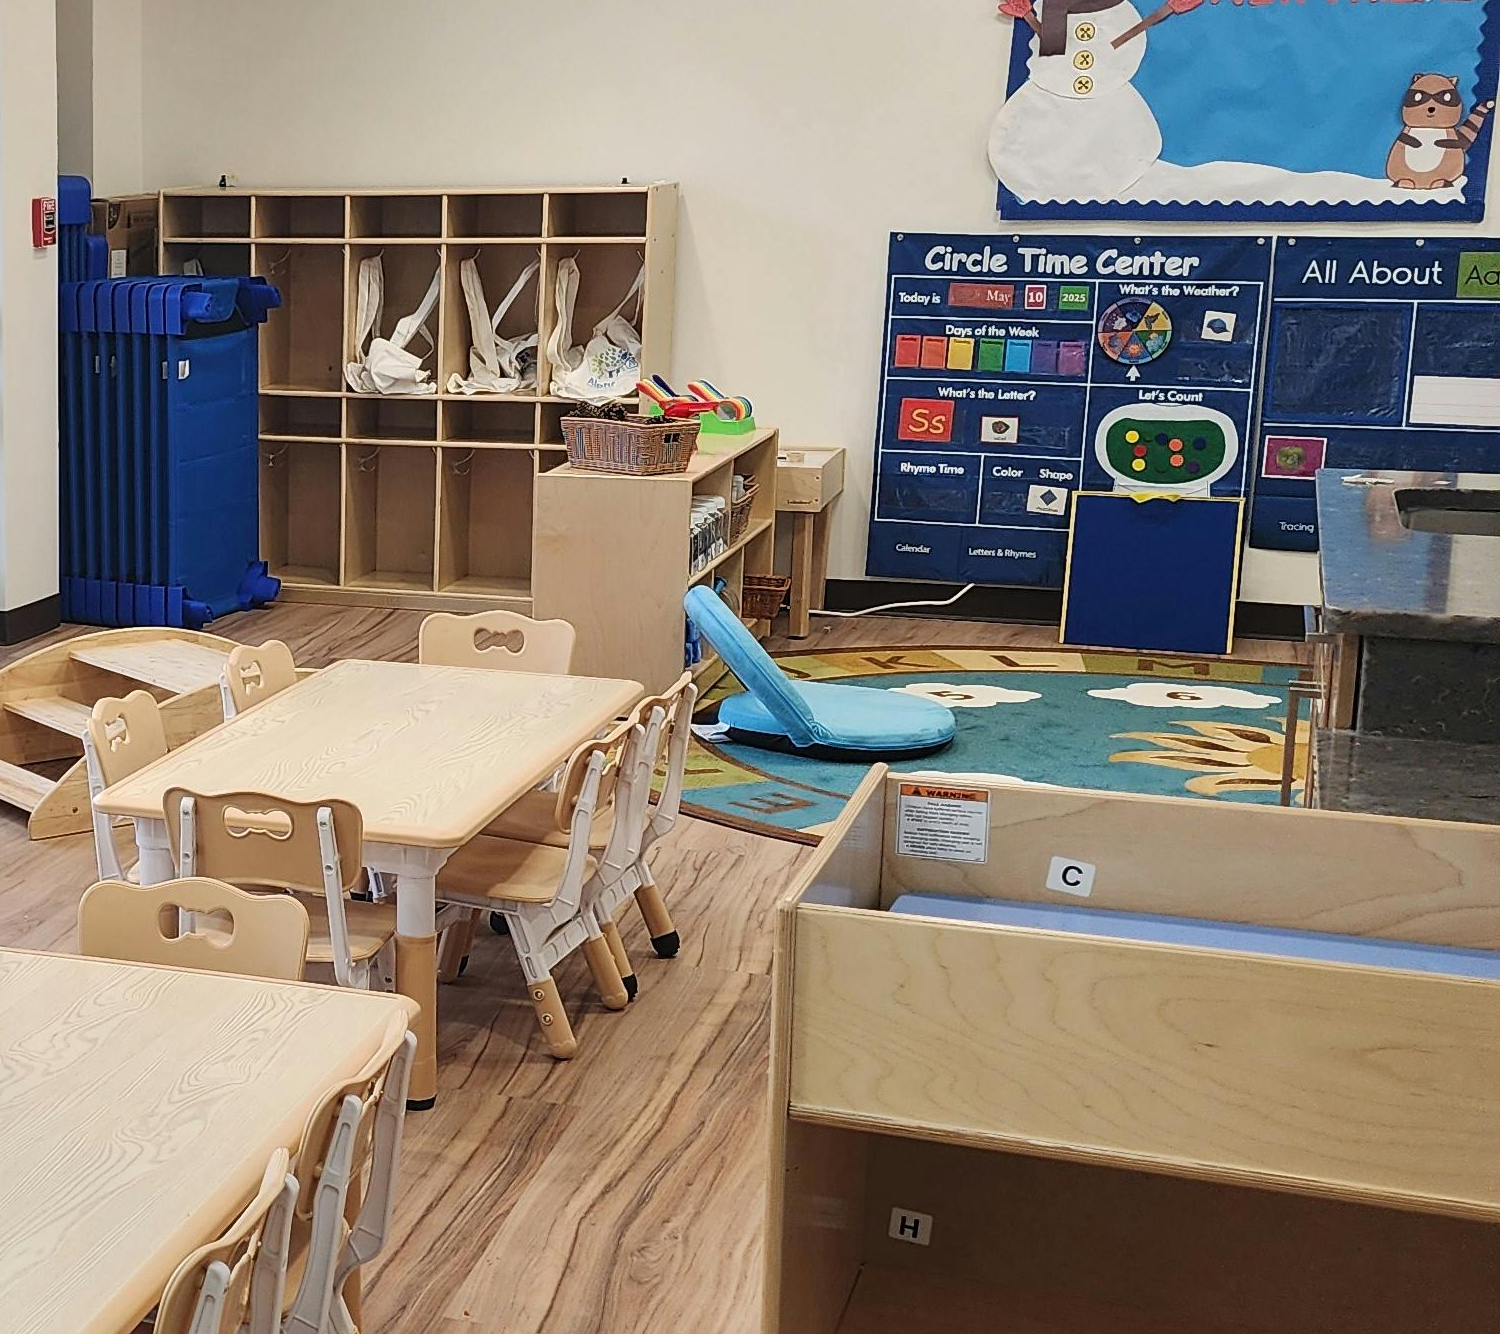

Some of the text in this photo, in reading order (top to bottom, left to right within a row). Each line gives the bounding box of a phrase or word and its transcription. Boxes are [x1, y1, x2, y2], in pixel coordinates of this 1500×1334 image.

[925, 246, 1200, 277] Circle Time Center
[1301, 259, 1337, 284] All
[1348, 260, 1443, 285] About
[1028, 291, 1043, 303] 10
[1118, 283, 1240, 297] What's the Weather?
[898, 292, 941, 306] Today is
[985, 290, 1012, 305] May
[1062, 293, 1086, 303] 2025
[945, 325, 1040, 338] Days of the Week
[938, 387, 1036, 401] What's the Letter?
[1138, 389, 1204, 403] Let's Count
[908, 408, 946, 434] Ss
[900, 463, 964, 475] Rhyme Time
[992, 466, 1024, 478] Color
[1039, 468, 1074, 481] Shape
[1279, 521, 1315, 534] Tracing
[895, 543, 931, 555] Calendar
[968, 548, 996, 557] Letters
[1004, 549, 1036, 560] Rhymes
[859, 655, 940, 670] K
[926, 789, 976, 799] WARNING
[1061, 865, 1084, 887] C
[898, 1215, 920, 1239] H
